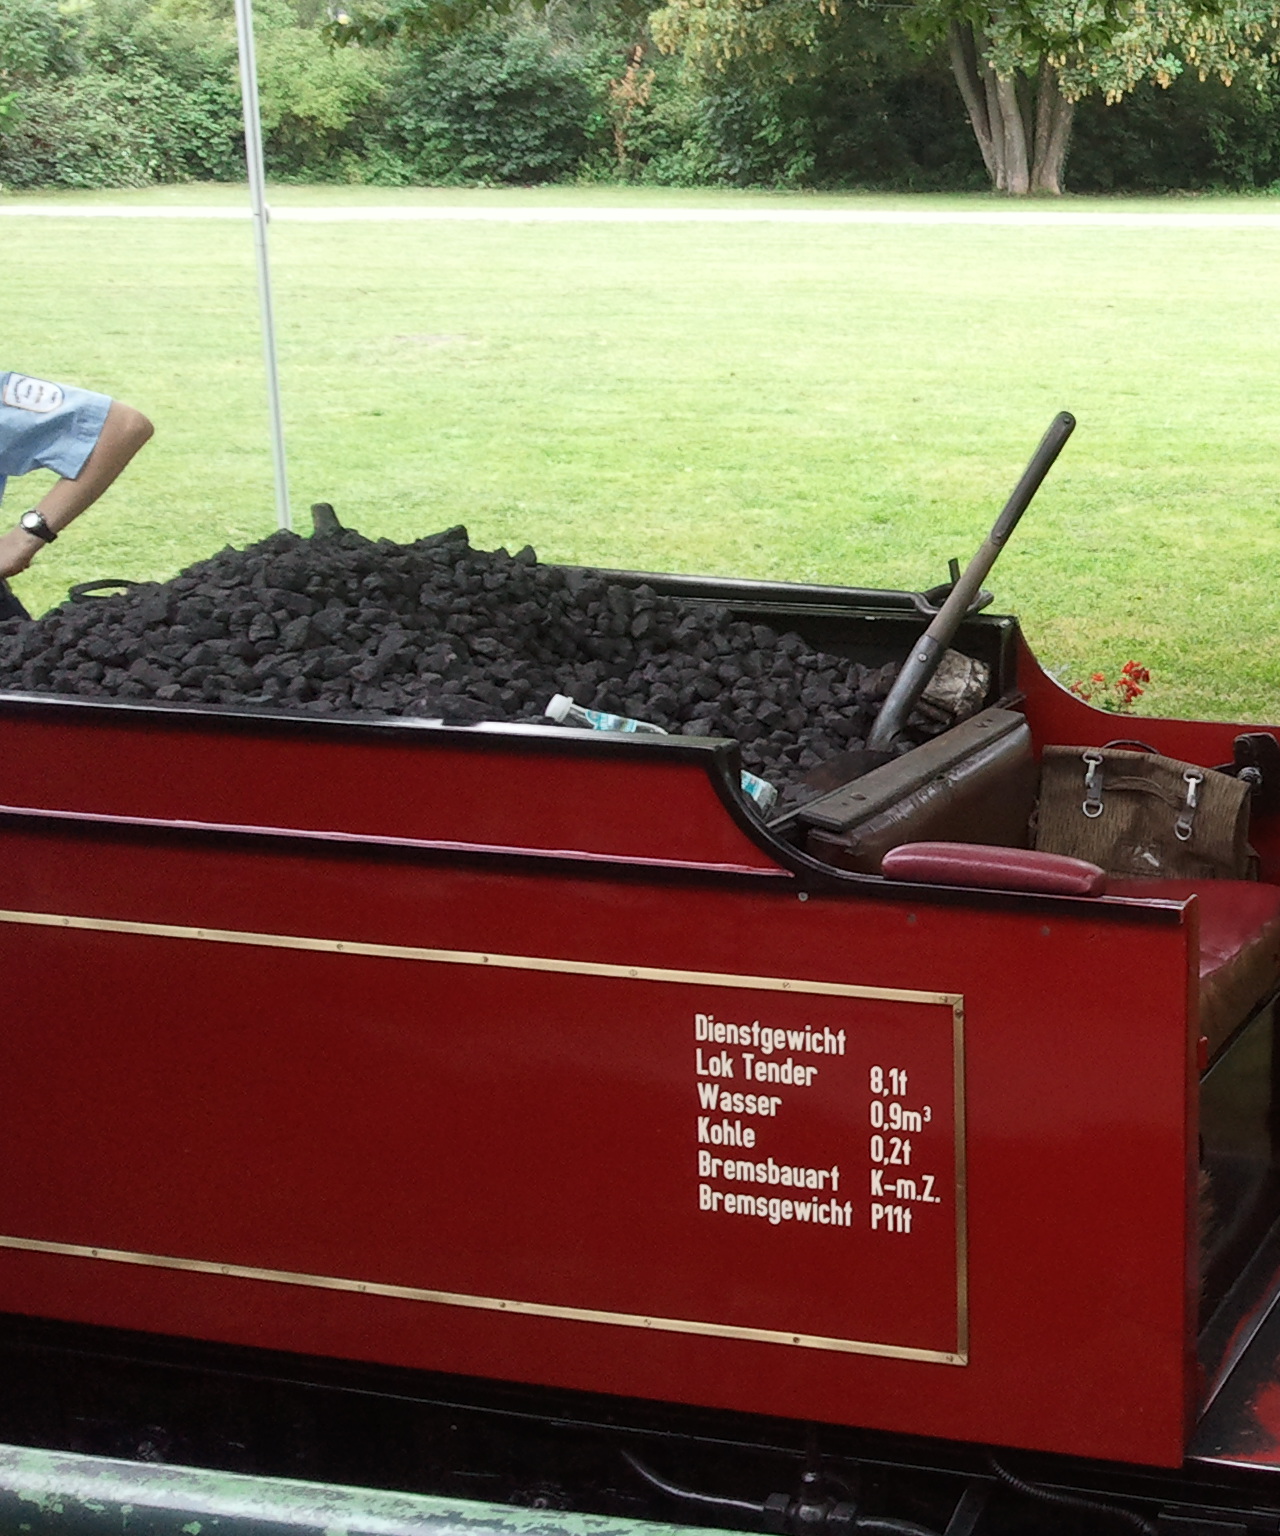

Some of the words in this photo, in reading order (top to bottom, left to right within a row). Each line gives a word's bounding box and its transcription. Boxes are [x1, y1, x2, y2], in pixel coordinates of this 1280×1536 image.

[695, 1014, 846, 1055] Dienstgewicht
[696, 1048, 734, 1078] Lok
[742, 1053, 818, 1087] Tender
[870, 1066, 908, 1097] 8,1t
[697, 1082, 782, 1117] Wasser
[698, 1116, 756, 1148] Kohle
[870, 1135, 912, 1166] 0,2t
[698, 1150, 840, 1192] Bremsbauart
[699, 1184, 852, 1227] Bremsgewicht
[871, 1203, 912, 1233] P11t
